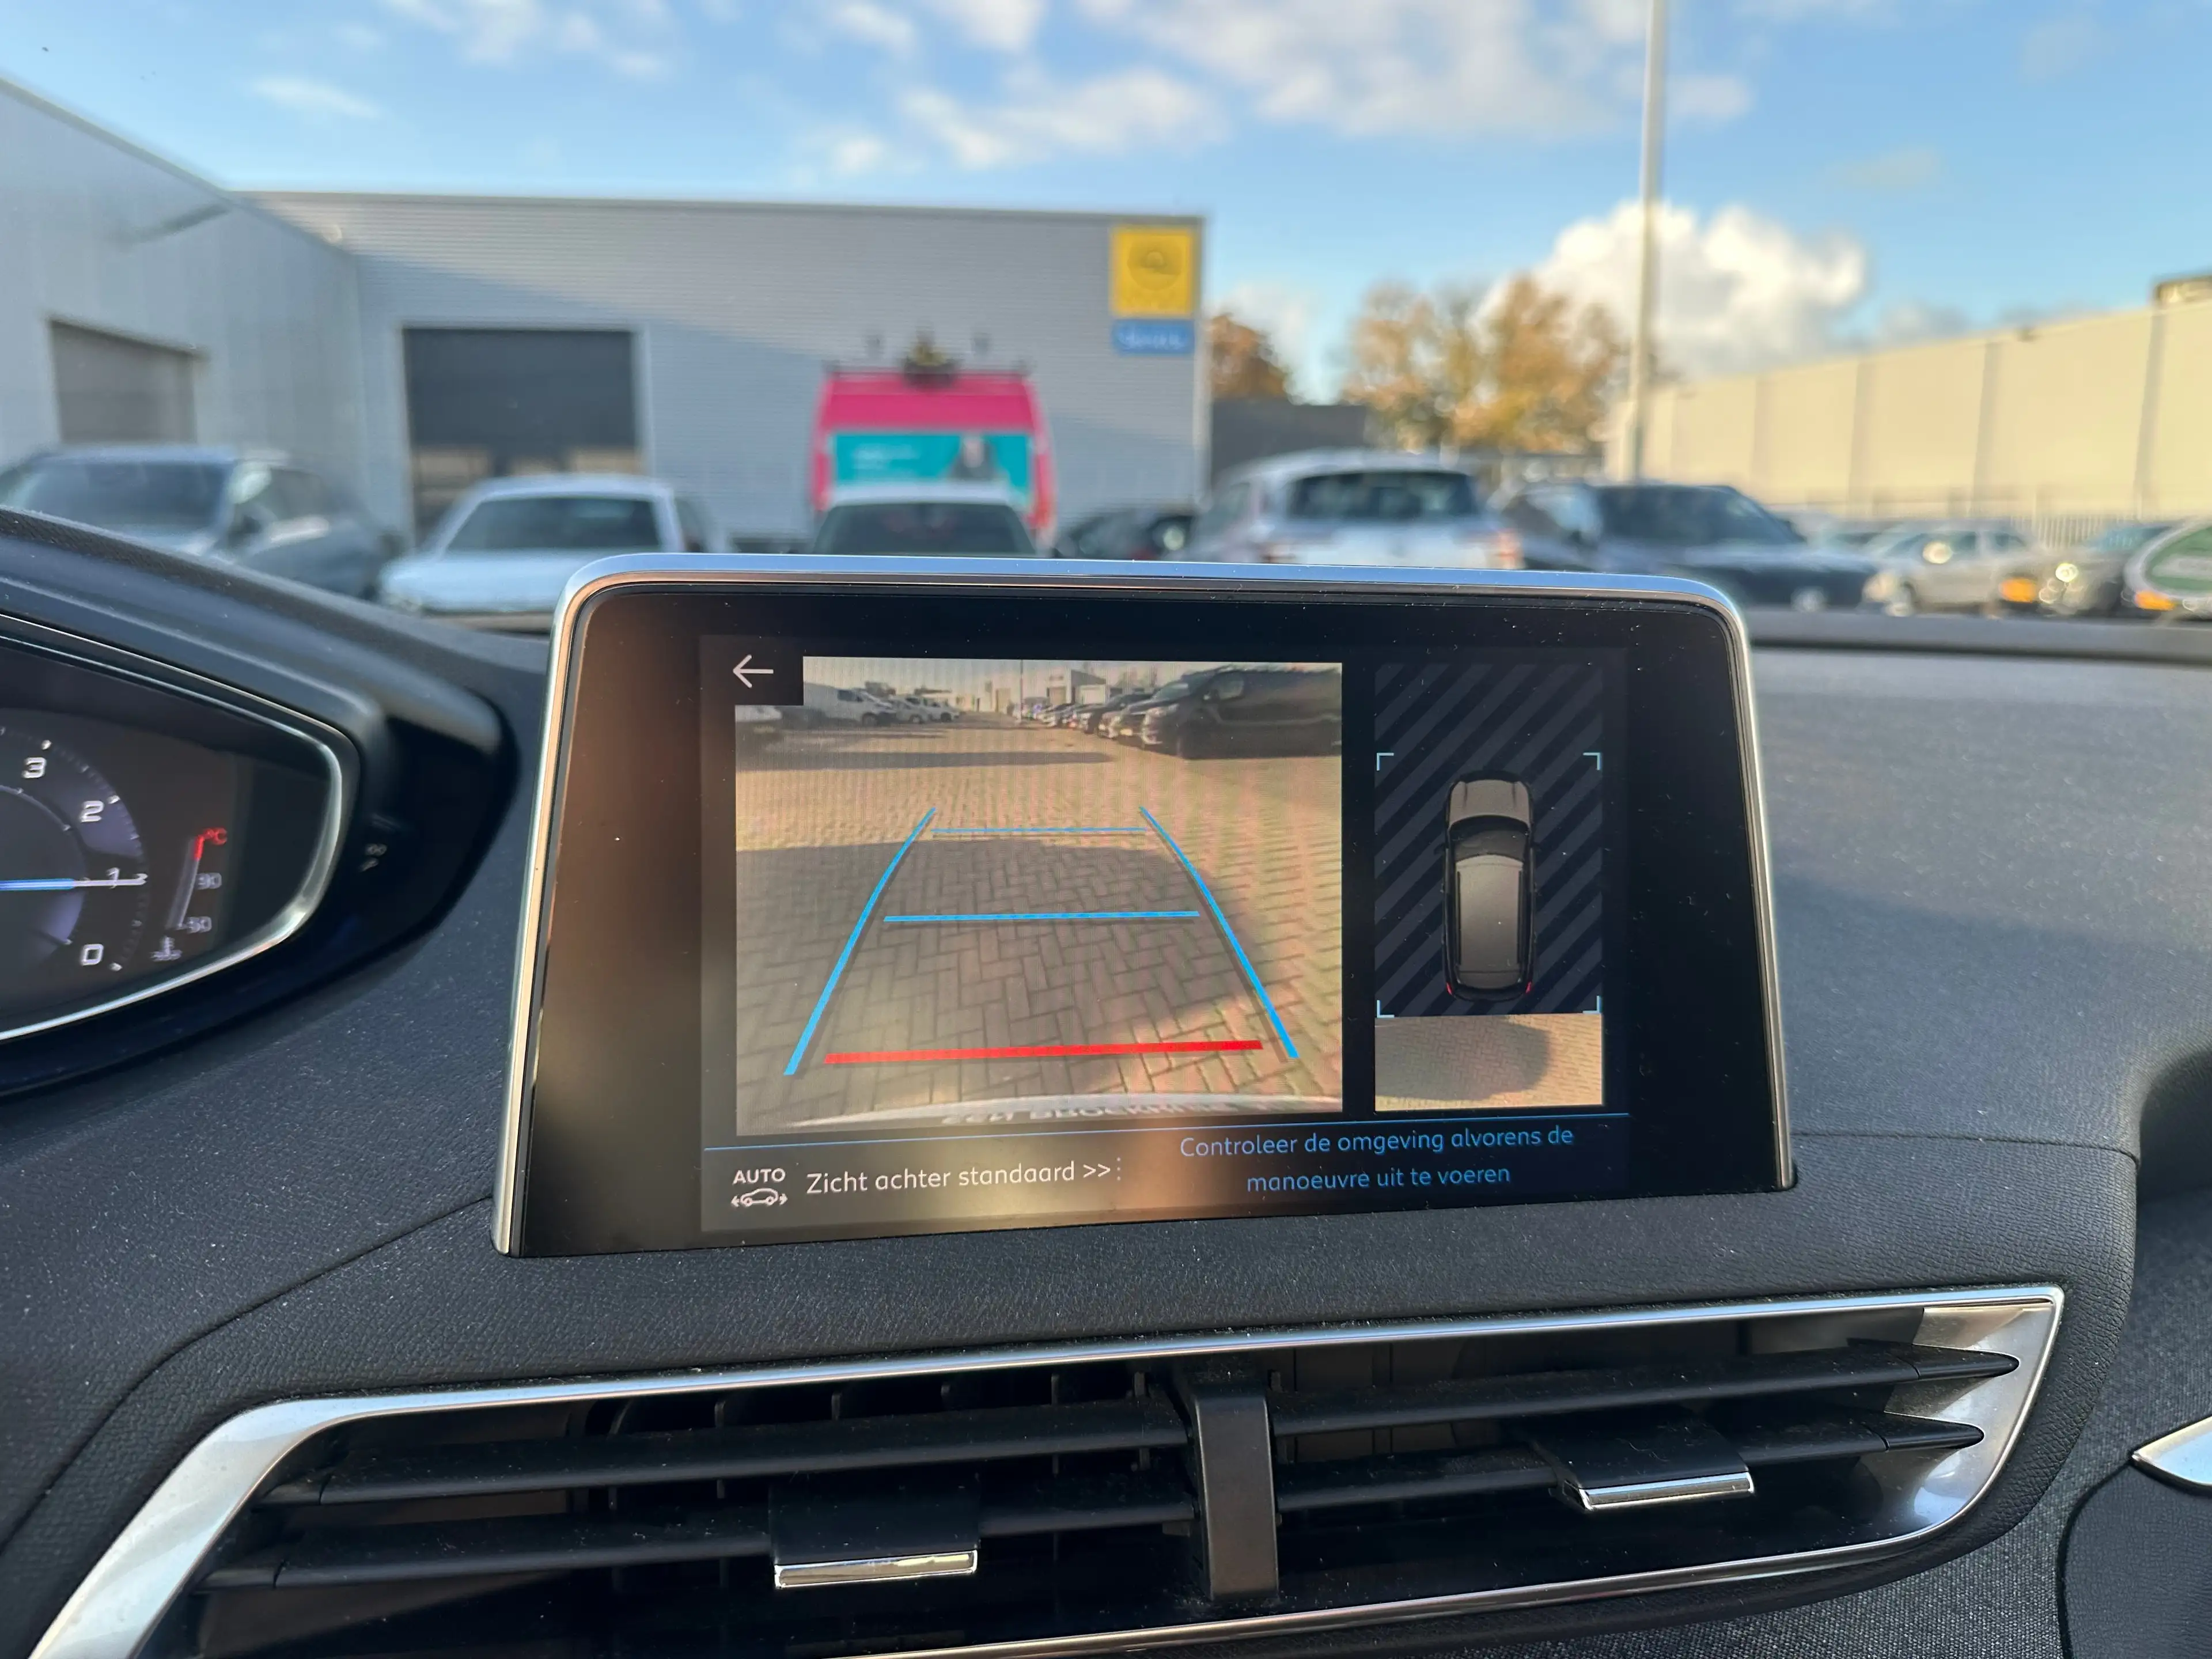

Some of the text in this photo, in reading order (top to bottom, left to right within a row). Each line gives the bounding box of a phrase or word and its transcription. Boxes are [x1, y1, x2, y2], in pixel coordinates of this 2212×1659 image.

[22, 756, 47, 778] 3
[81, 800, 104, 822] 2
[81, 944, 104, 965] 0
[1180, 1126, 1573, 1157] Controleer de omgeving alvorens de
[733, 1168, 786, 1184] AUTO
[806, 1172, 868, 1194] Zicht
[875, 1169, 950, 1191] achter
[959, 1161, 1075, 1186] standaard
[1247, 1167, 1510, 1192] manoeuvre uit te voeren
